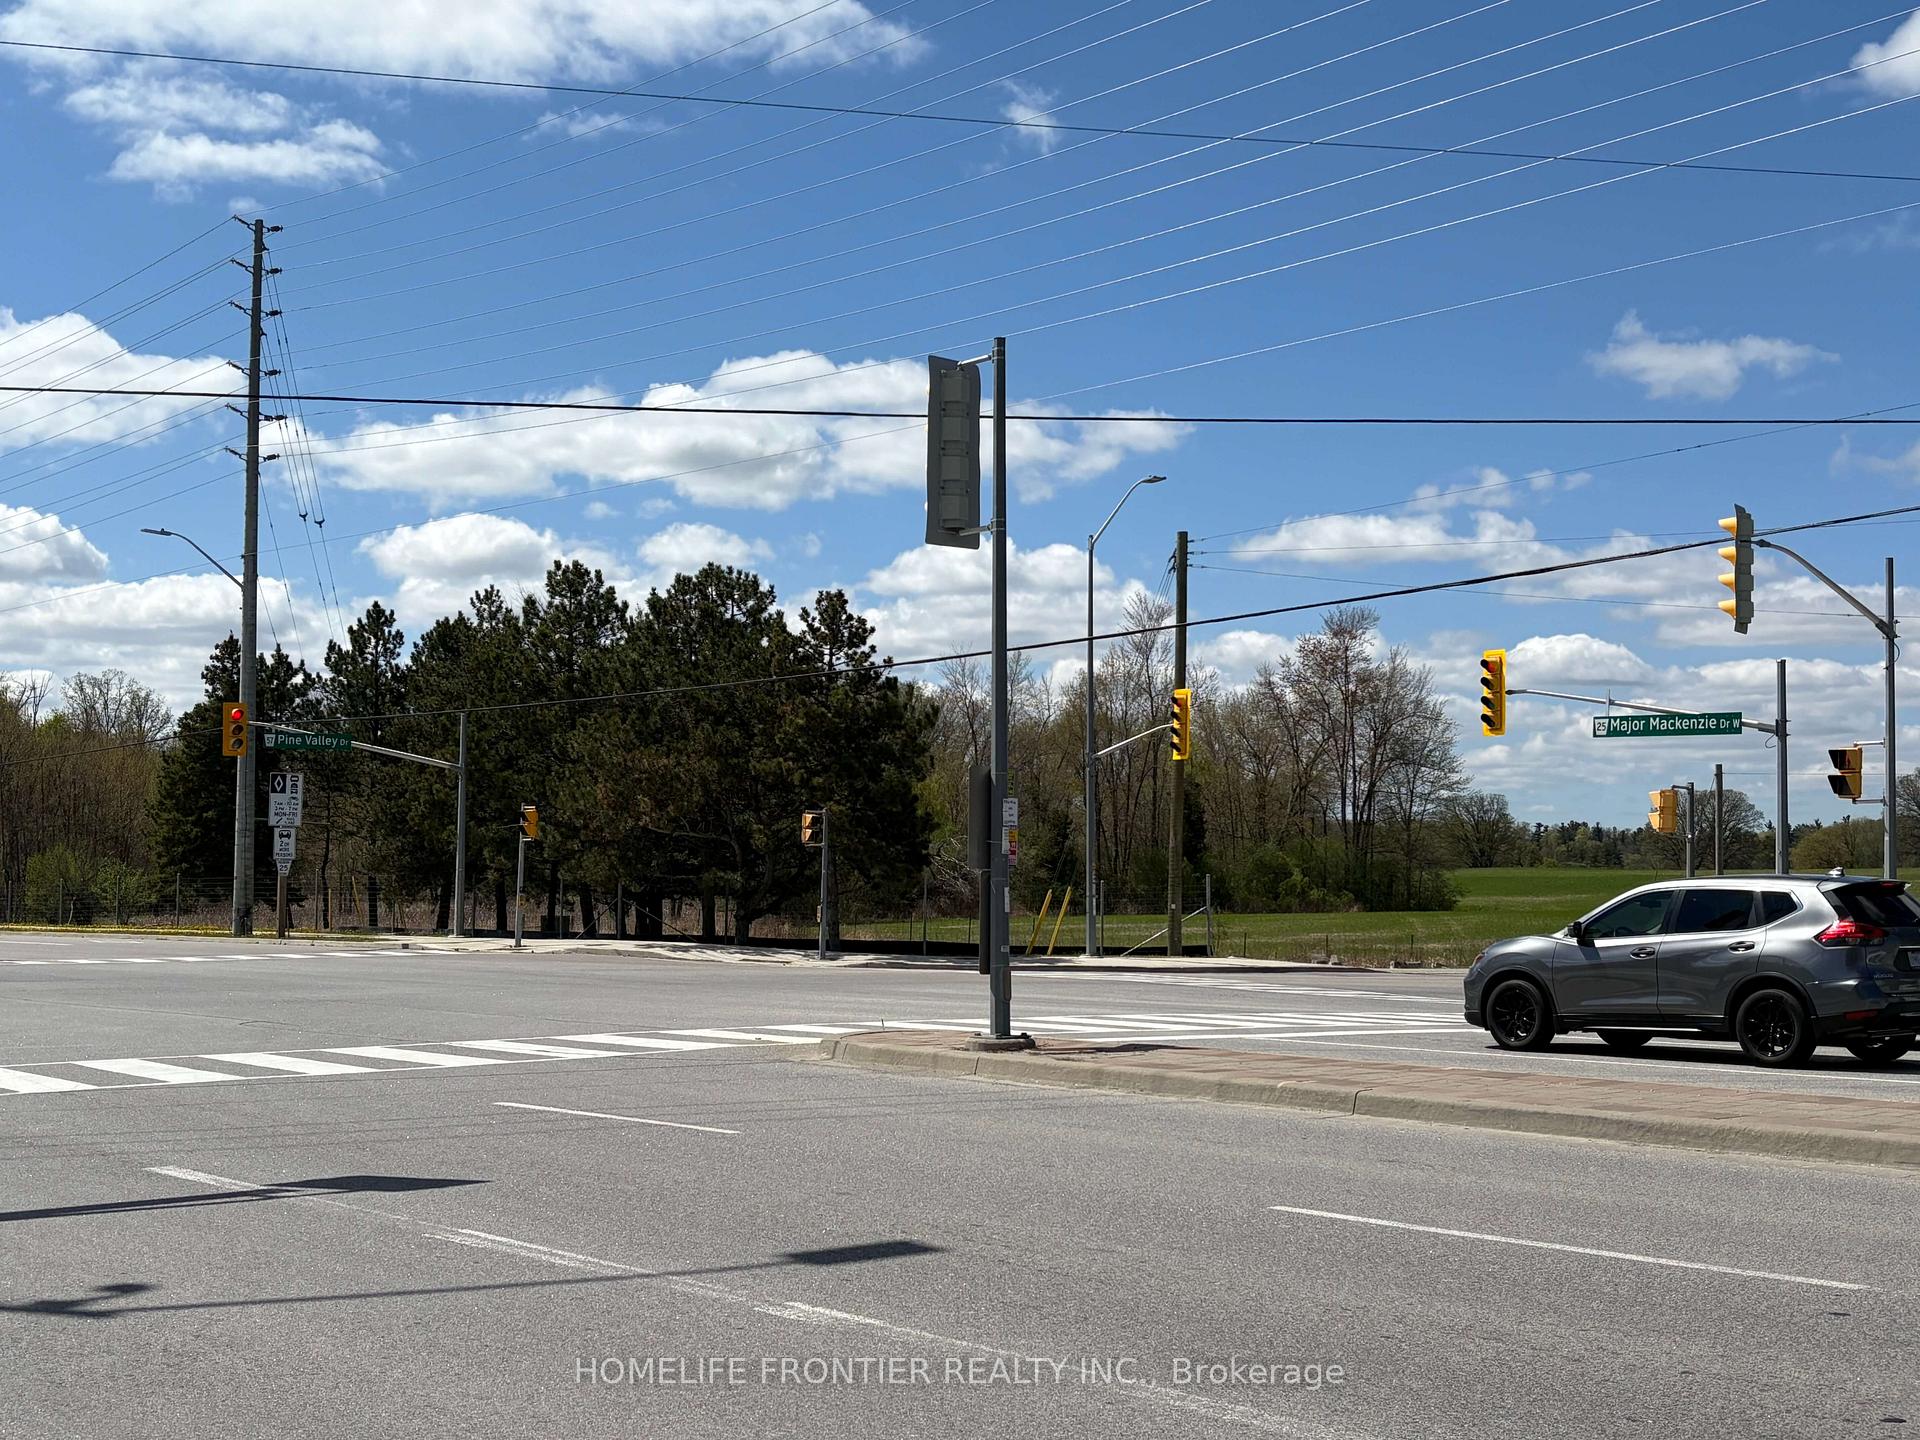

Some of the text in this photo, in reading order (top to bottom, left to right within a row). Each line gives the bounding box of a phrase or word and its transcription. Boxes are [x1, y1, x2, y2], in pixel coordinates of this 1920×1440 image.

[1597, 721, 1606, 732] 25
[1610, 715, 1740, 734] Major Mackenzie Dr W
[266, 736, 274, 745] 57
[277, 734, 349, 748] Pine Valley Dr
[279, 864, 288, 872] 25
